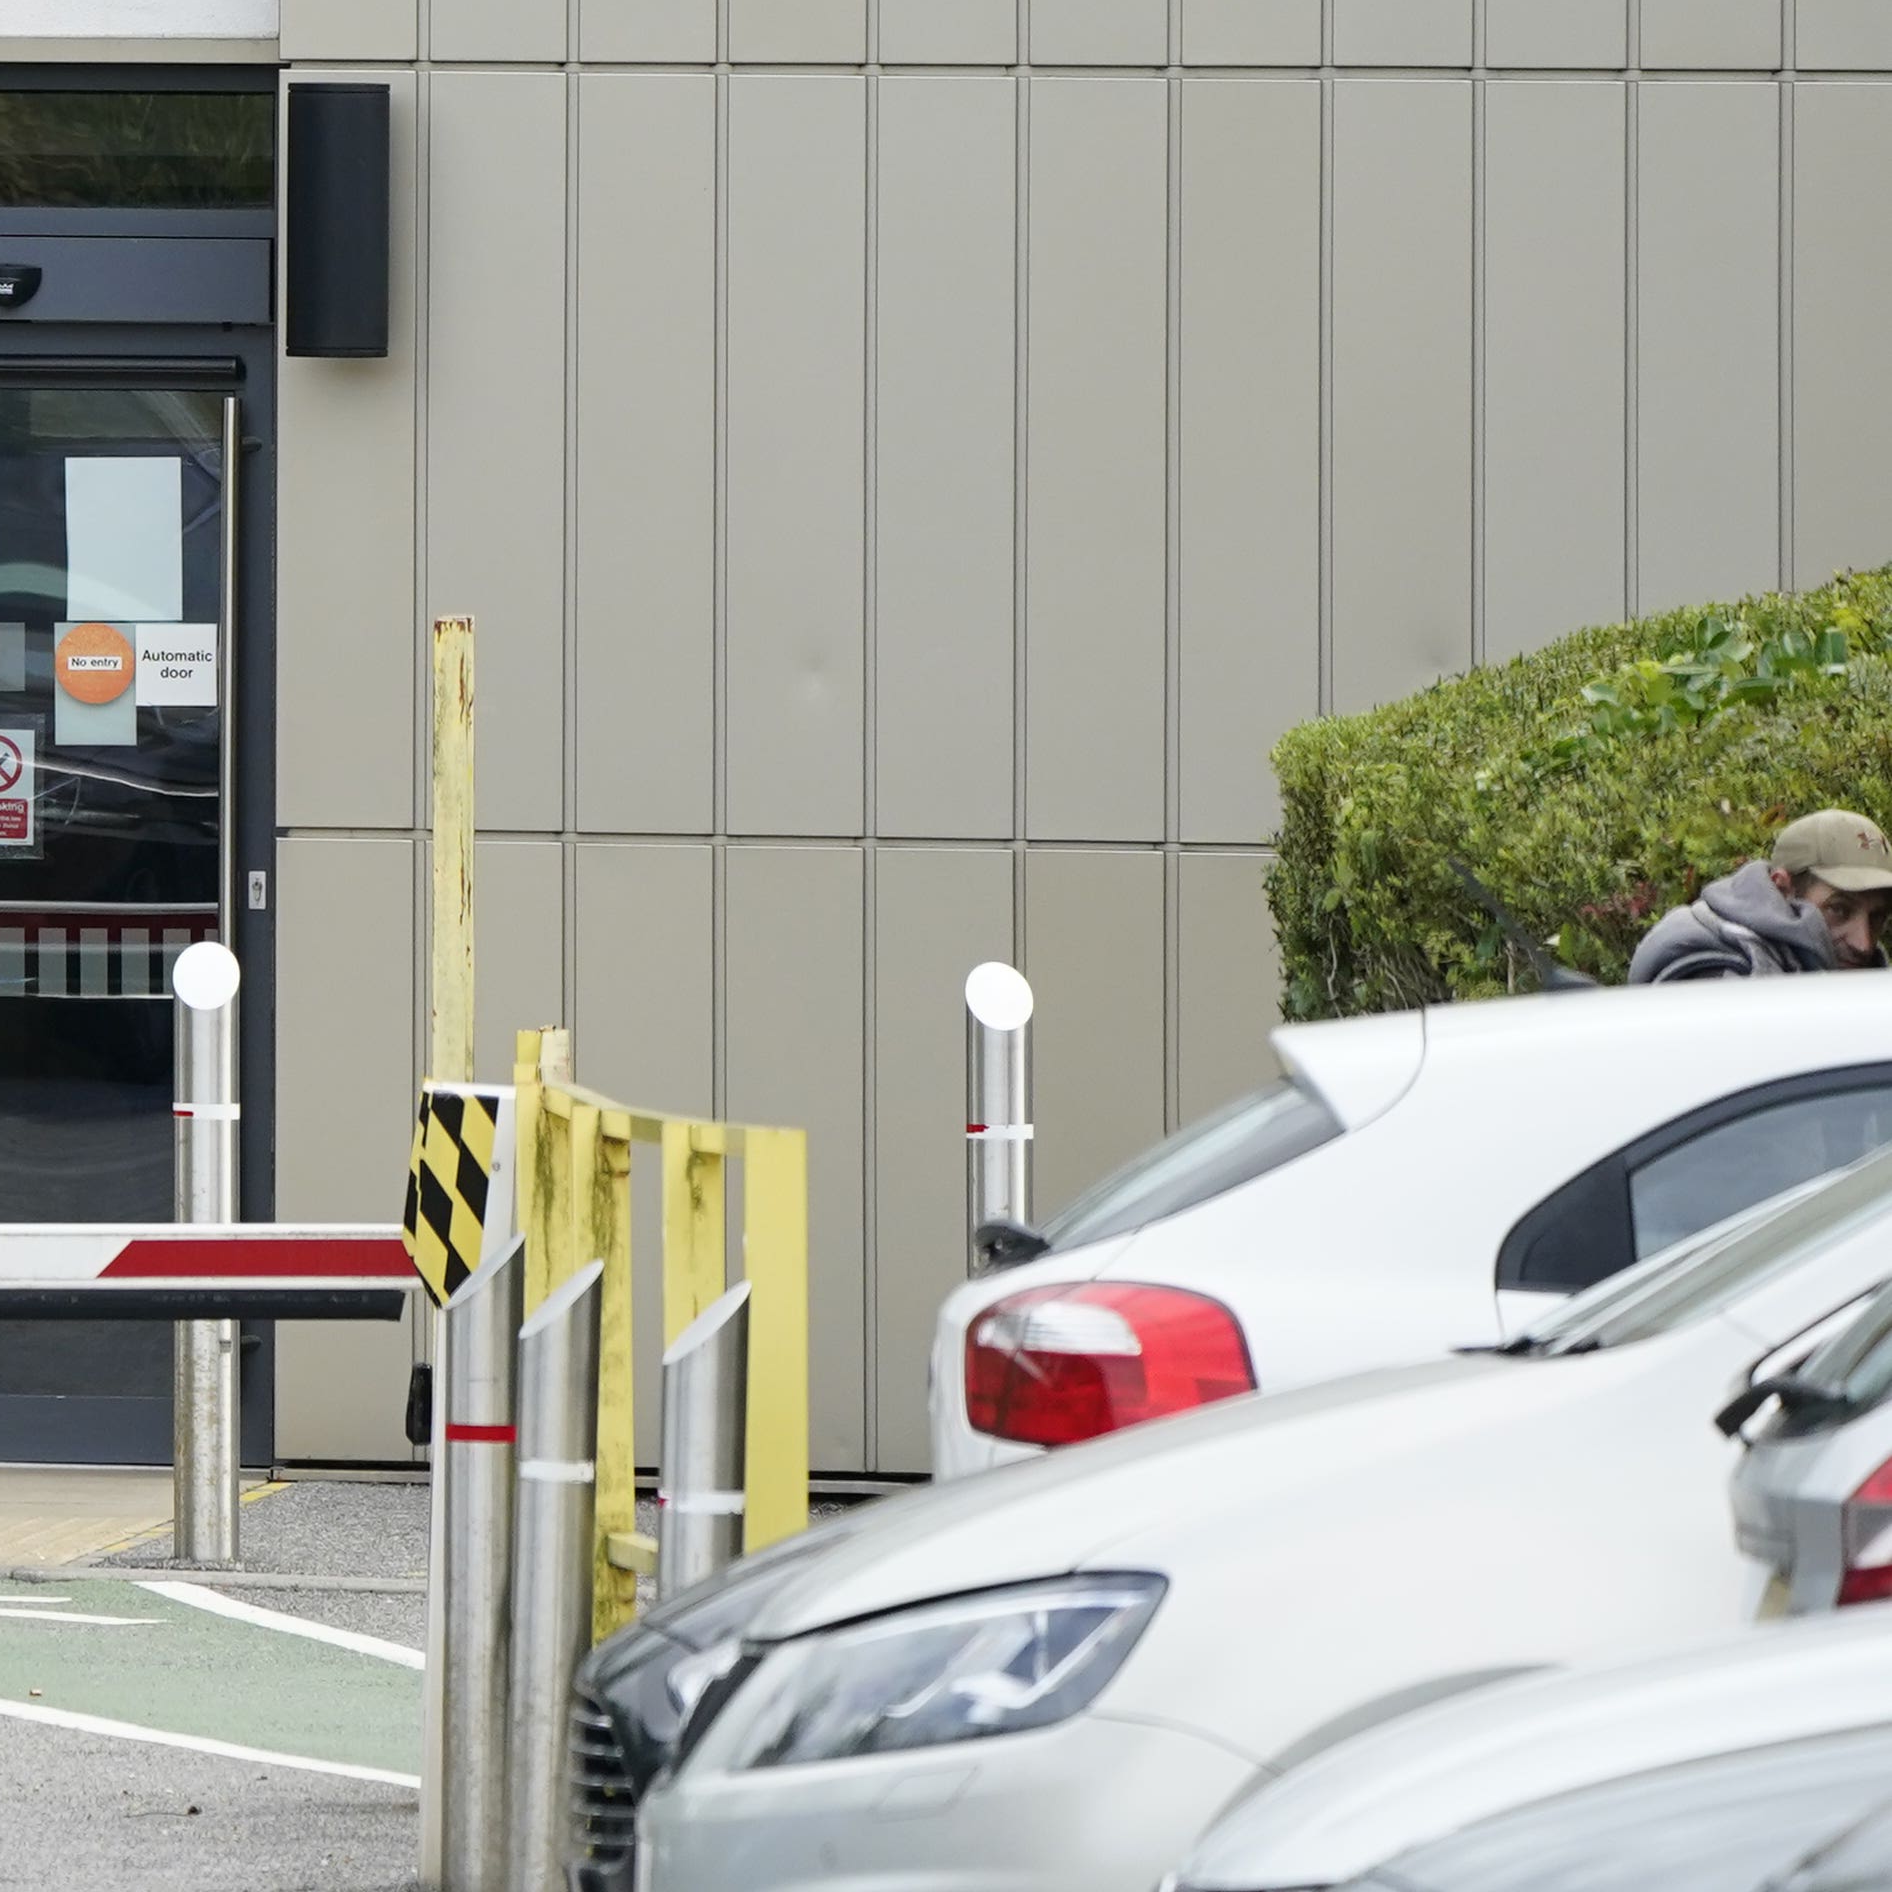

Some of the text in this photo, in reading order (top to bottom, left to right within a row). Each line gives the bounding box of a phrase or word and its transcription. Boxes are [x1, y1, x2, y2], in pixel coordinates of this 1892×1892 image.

[142, 649, 213, 662] Automatic
[71, 658, 119, 668] No entry
[160, 667, 194, 679] door
